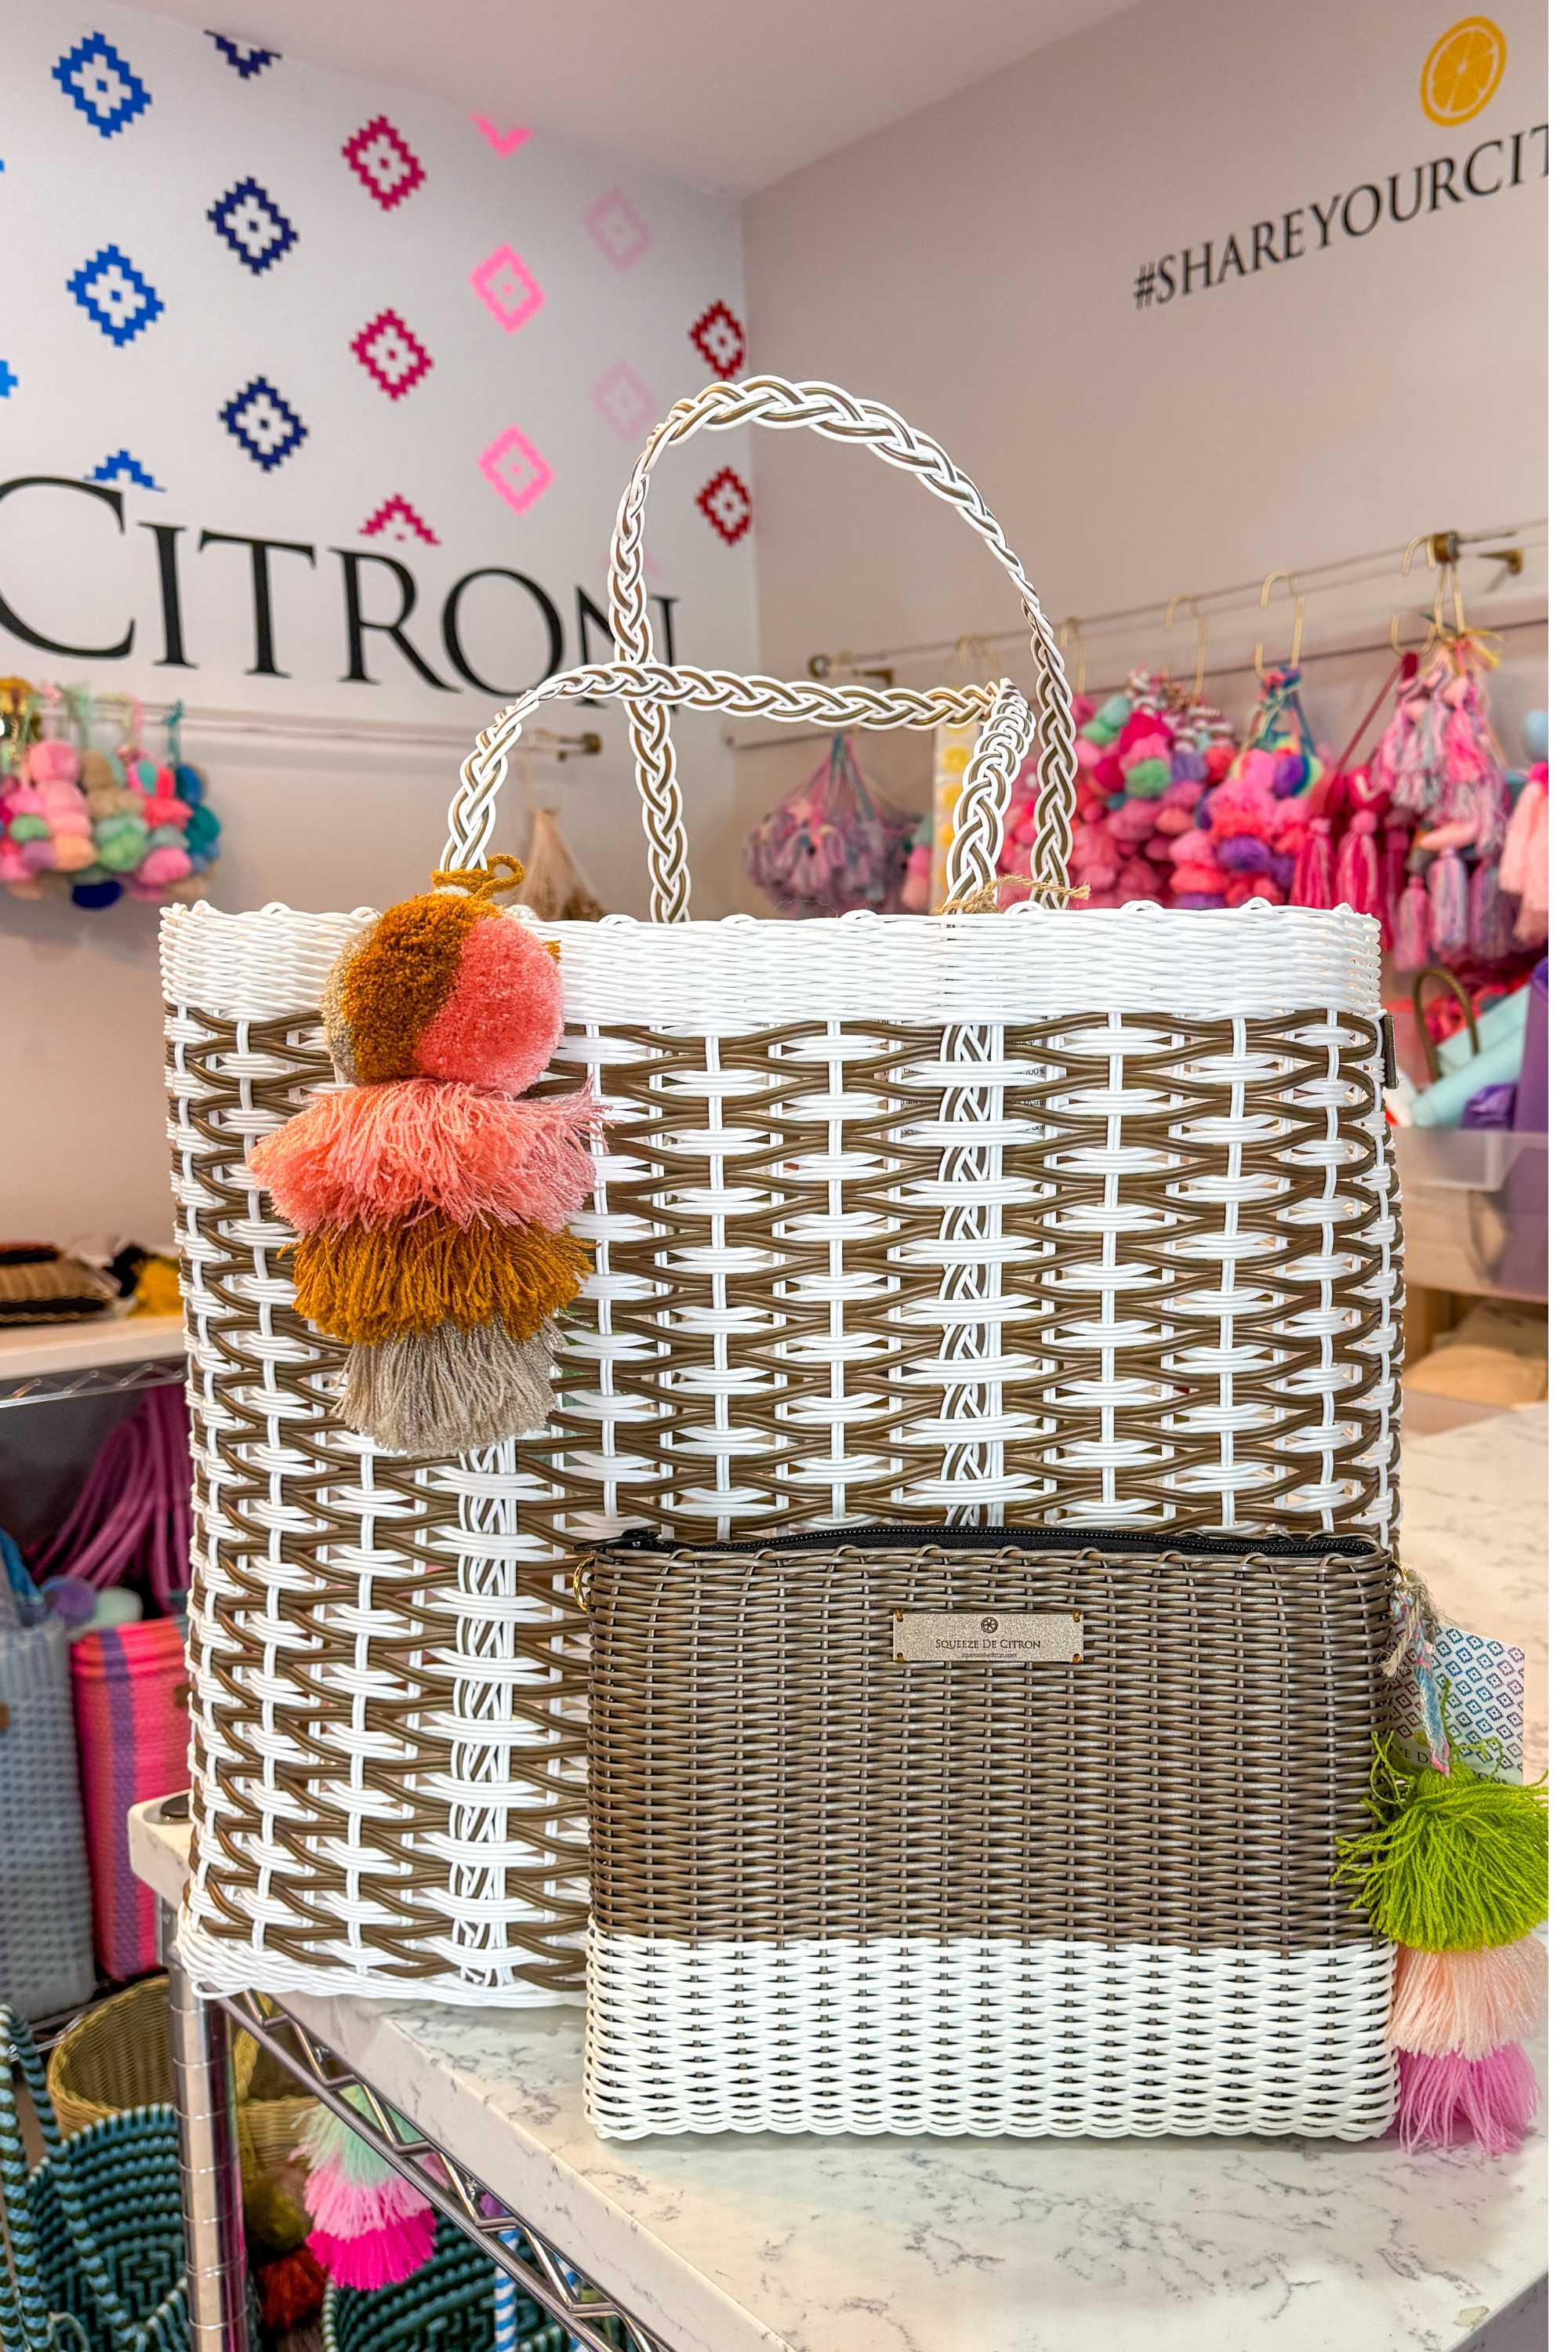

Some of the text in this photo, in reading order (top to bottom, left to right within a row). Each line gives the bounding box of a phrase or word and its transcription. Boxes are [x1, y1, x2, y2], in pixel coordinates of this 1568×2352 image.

[0, 476, 681, 713] CITRON
[935, 1639, 1041, 1650] SQUEEZE DE CITRON
